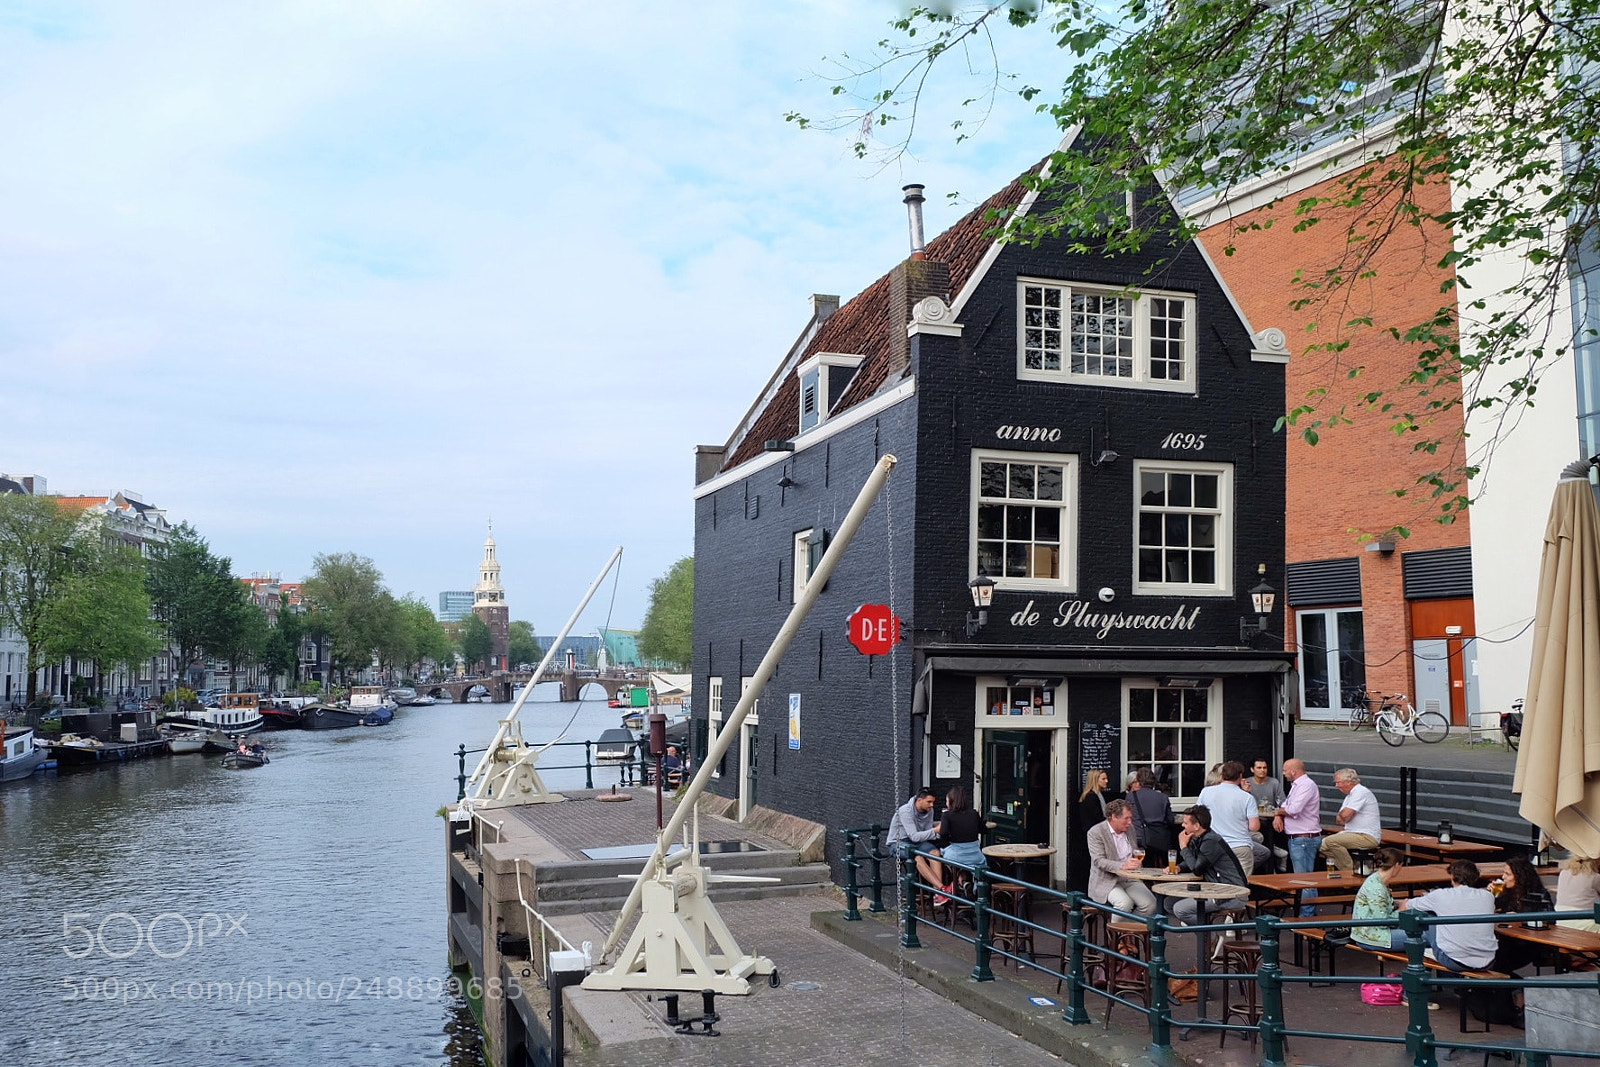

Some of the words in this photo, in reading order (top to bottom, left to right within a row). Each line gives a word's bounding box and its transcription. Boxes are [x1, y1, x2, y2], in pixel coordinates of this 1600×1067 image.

[996, 424, 1062, 442] anno
[1160, 431, 1208, 451] 1695
[1010, 600, 1040, 626] de
[1053, 600, 1201, 640] Sluyswacht
